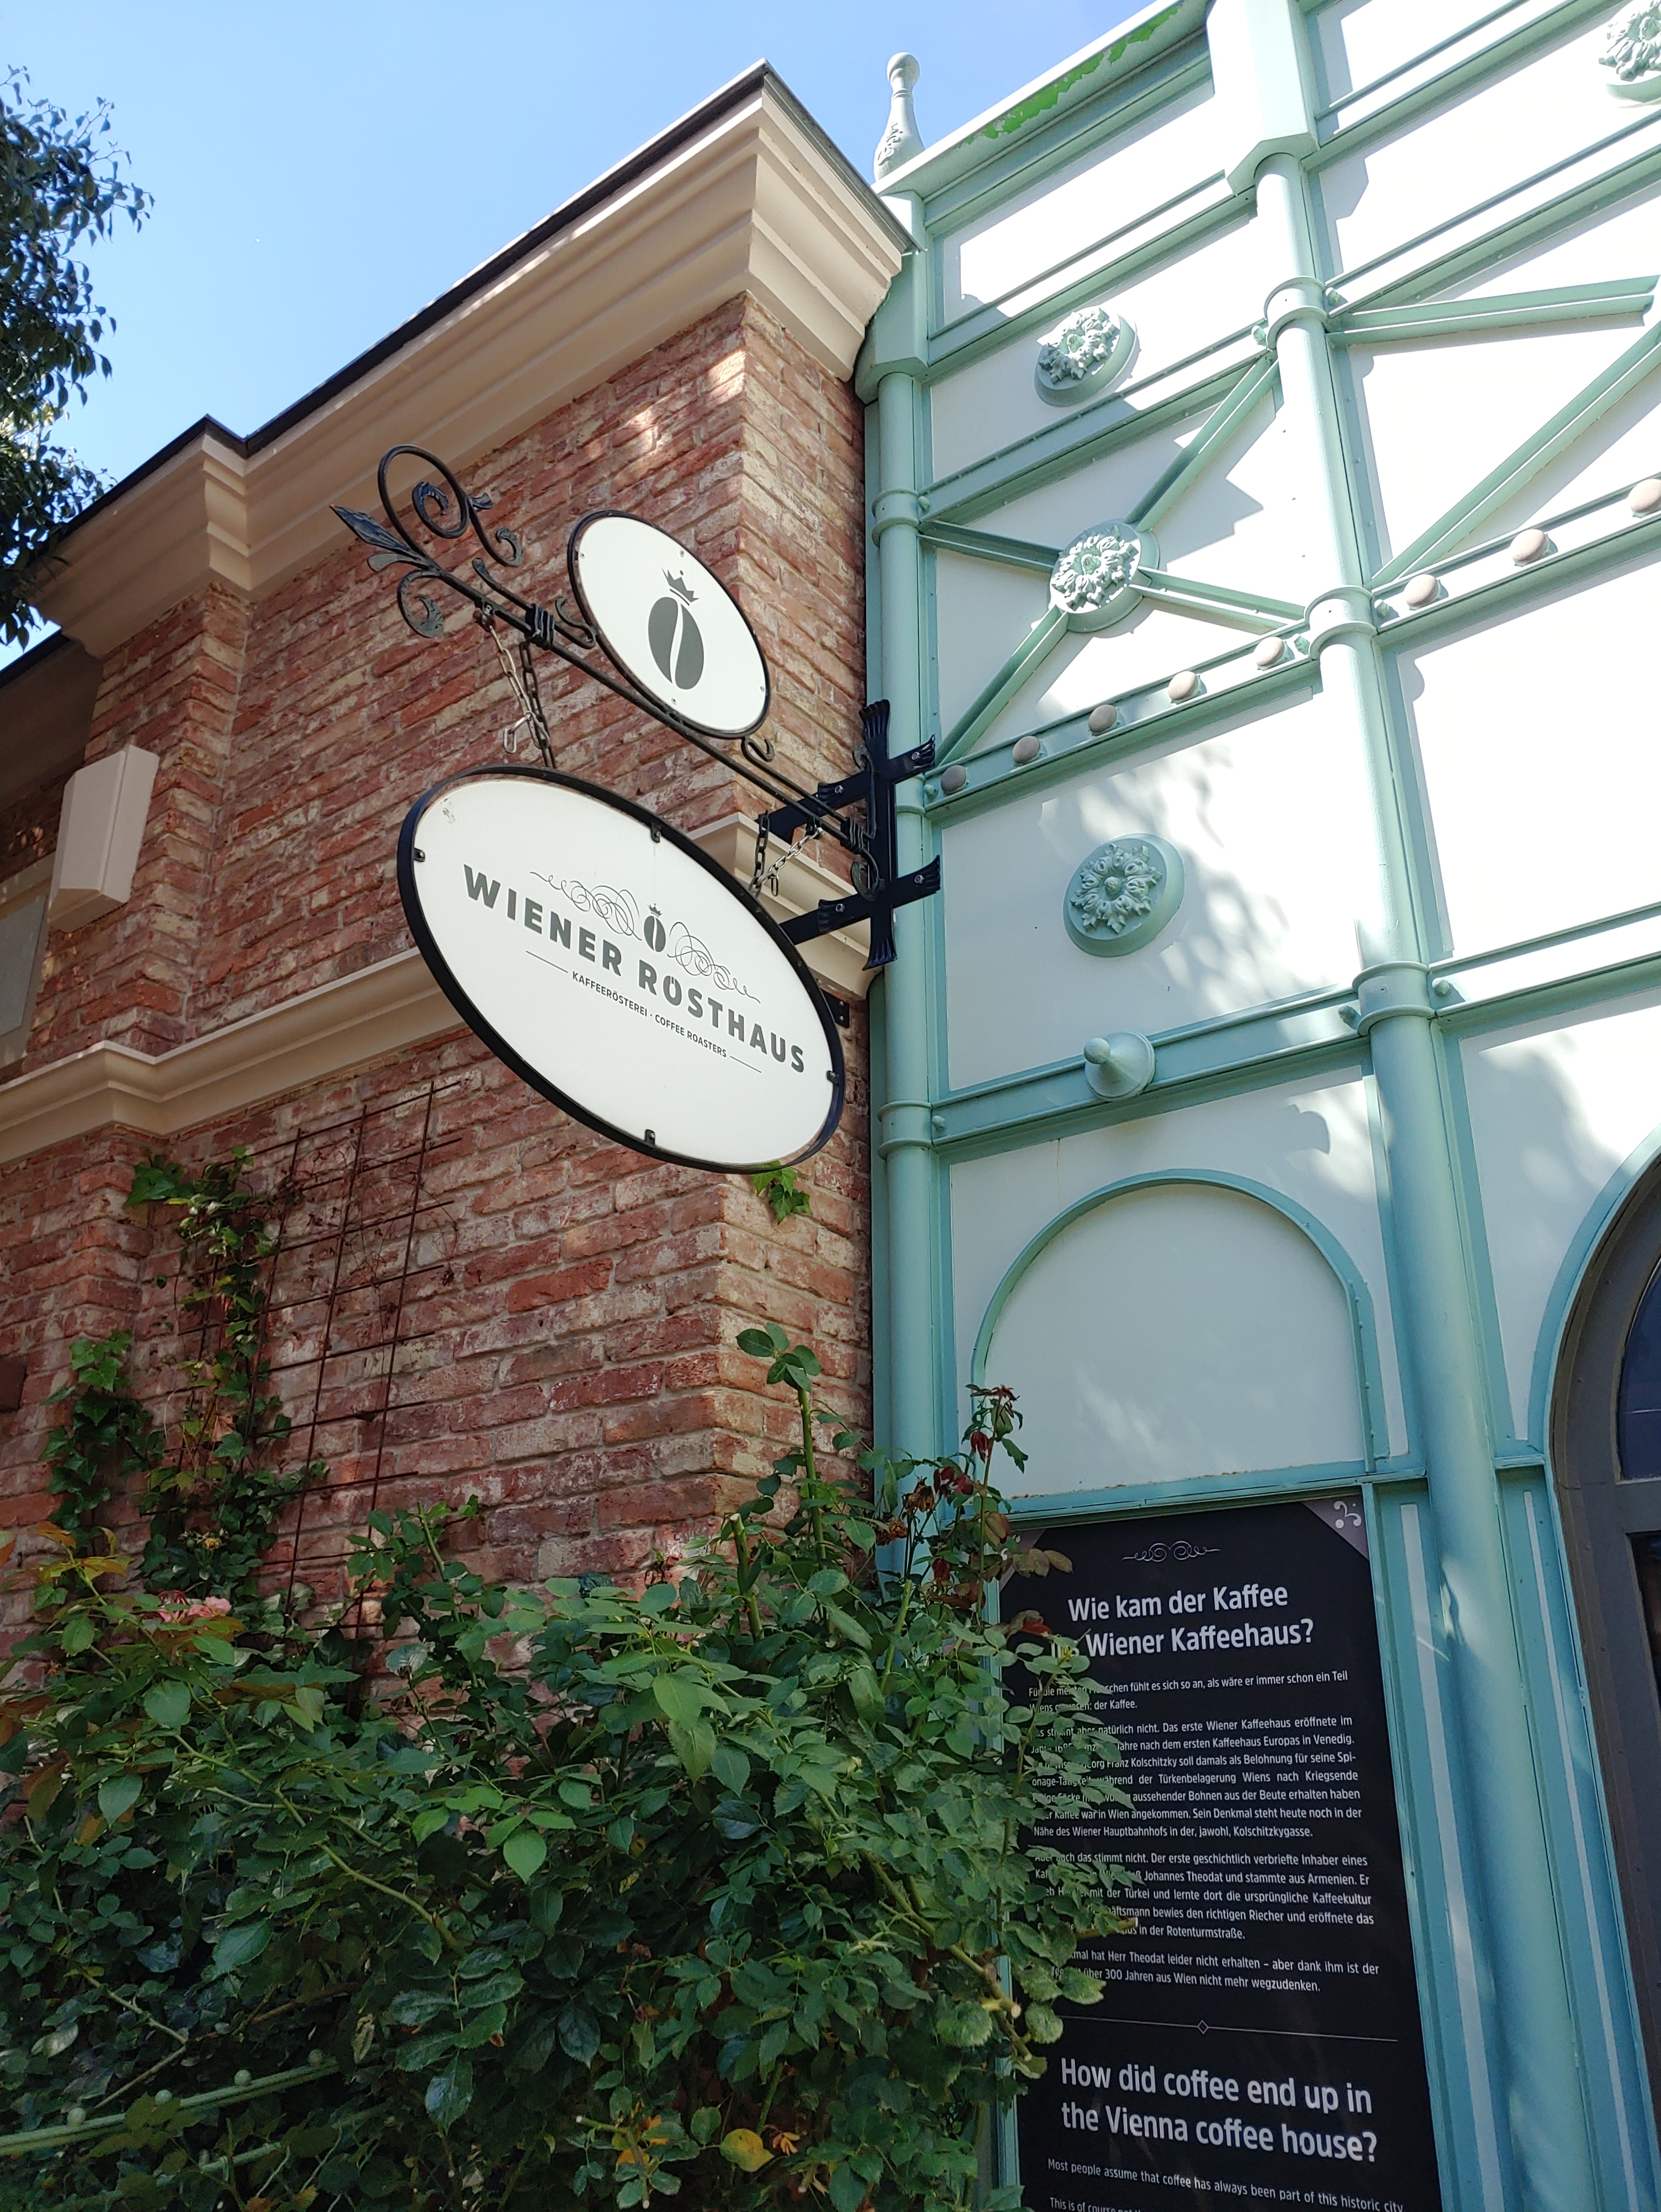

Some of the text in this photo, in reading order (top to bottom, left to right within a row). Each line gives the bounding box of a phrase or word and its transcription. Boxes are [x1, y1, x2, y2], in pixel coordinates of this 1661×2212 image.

[463, 864, 622, 977] WIENER
[572, 971, 727, 1057] KAFFEERÖSTEREI COFFEE ROASTERS
[1067, 1584, 1288, 1621] Wie kam der Kaffee
[1085, 1618, 1313, 1657] Wiener Kaffeehaus?
[1130, 1670, 1348, 1692] fühlt es sich so an, als wäre er immer schon ein Teil
[1094, 1699, 1137, 1710] der Kaffee.
[1137, 1715, 1353, 1733] nicht. Das erste Wiener Kaffeehaus eröffnete im
[1140, 1733, 1354, 1750] nach dem ersten Kaffeehaus Europas in Venedig.
[1131, 1751, 1356, 1768] Kolschitzky soll damals als Belohnung für seine Spi-
[1139, 1770, 1358, 1785] der Türkenbelagerung Wiens nach Kriegsende
[1132, 1788, 1360, 1802] aussehender Bohnen aus der Beute erhalten haben
[1081, 1807, 1362, 1820] war Wien angekommen. Sein Denkmal steht heute noch in der
[1034, 1826, 1313, 1838] Nähe des Wiener Hauptbahnhofs in der, jawohl, Kolschitzkygasse.
[1077, 1852, 1368, 1866] das stimmt nicht. Der erste geschichtlich verbriefte Inhaber eines
[1144, 1870, 1370, 1885] Johannes Theodat und stammte aus Armenien. Er
[1107, 1887, 1372, 1905] der Türkei und lernte dort die ursprüngliche Kaffeekultur
[1152, 1906, 1374, 1925] bewies den richtigen Riecher und eröffnete das
[1150, 1924, 1245, 1940] der Rotenturmstraße.
[1091, 1950, 1379, 1974] hat Herr Theodat leider nicht erhalten aber dank ihm ist der
[1105, 1968, 1321, 1991] 300 Jahren aus Wien nicht mehr wegzudenken.
[1061, 2058, 1372, 2114] How did coffee end up in
[1061, 2102, 1377, 2162] the Vienna coffee house?
[1048, 2159, 1380, 2211] Most people assume that coffee has always been part of this historic
